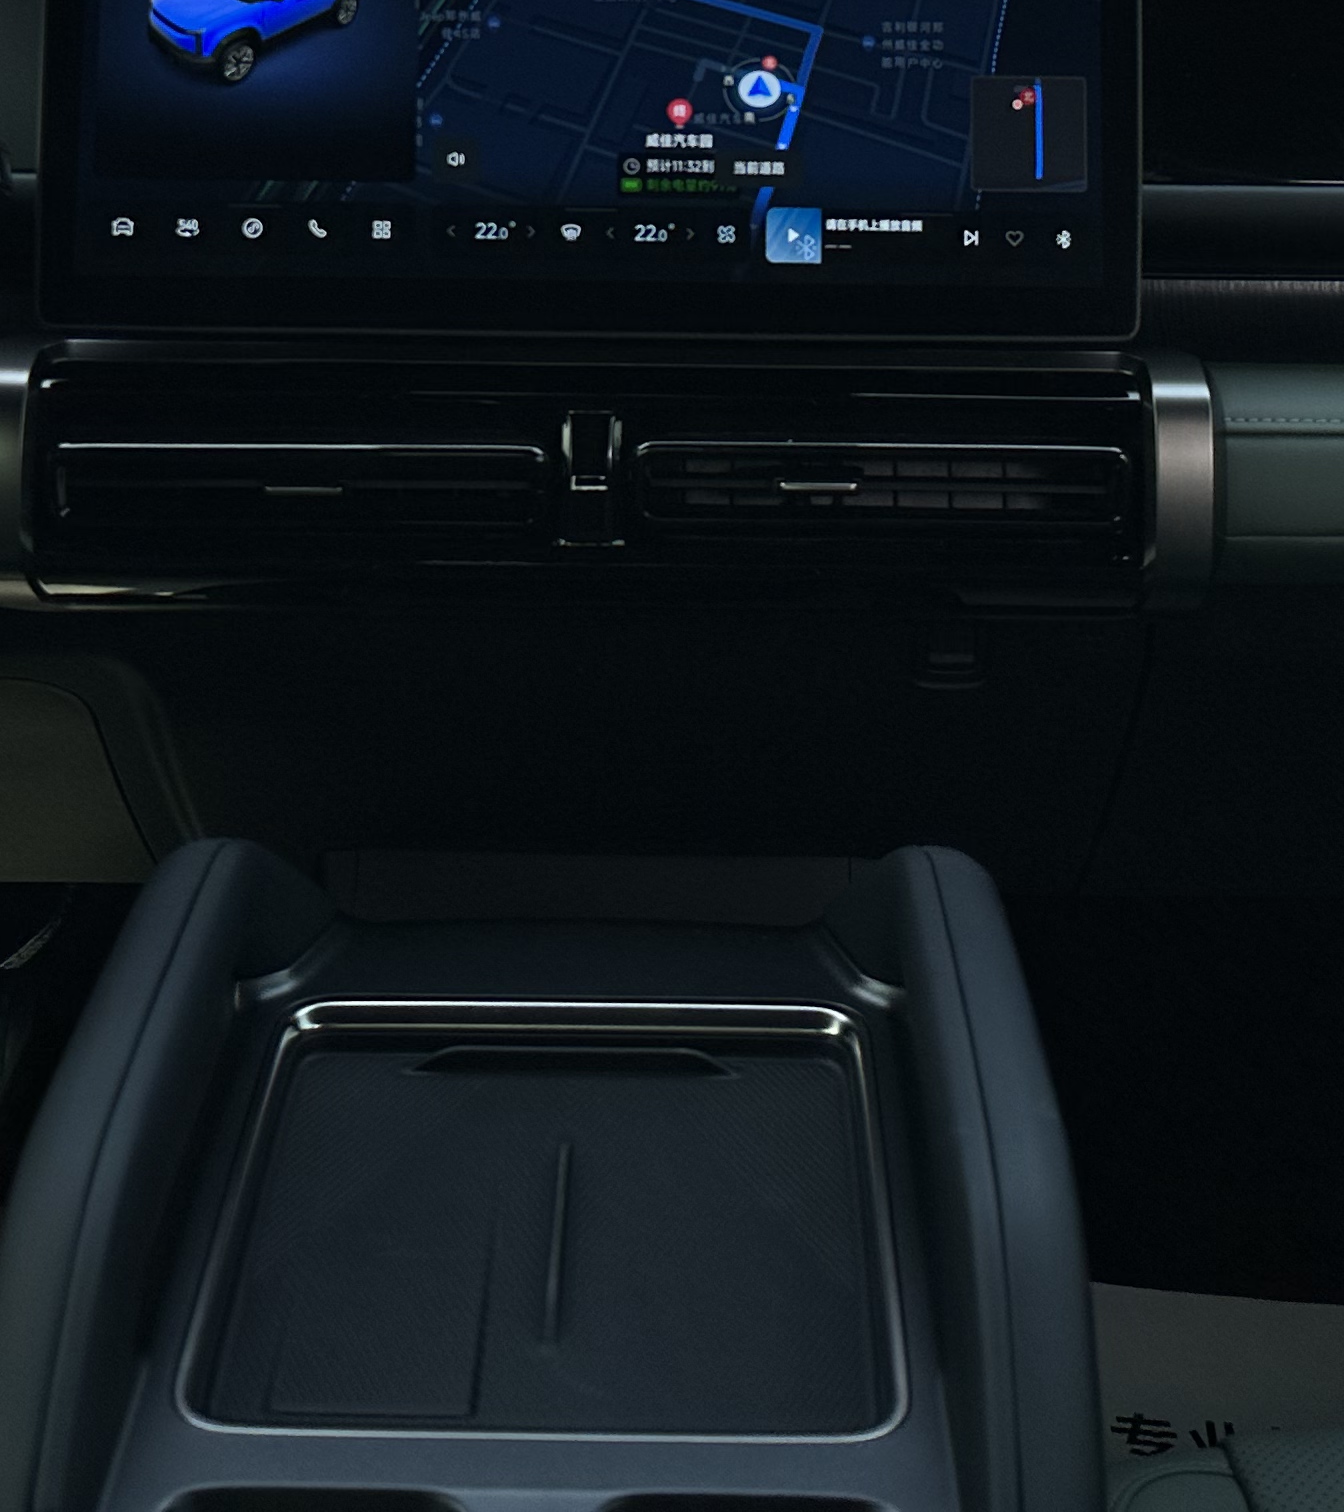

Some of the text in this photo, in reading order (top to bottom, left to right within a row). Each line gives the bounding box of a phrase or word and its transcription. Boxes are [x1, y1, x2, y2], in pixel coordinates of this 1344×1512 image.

[645, 133, 714, 149] 威佳汽车园
[646, 158, 715, 173] 预计11:32到
[733, 160, 786, 176] 当前道路
[826, 218, 924, 233] 请在手机上播放音频
